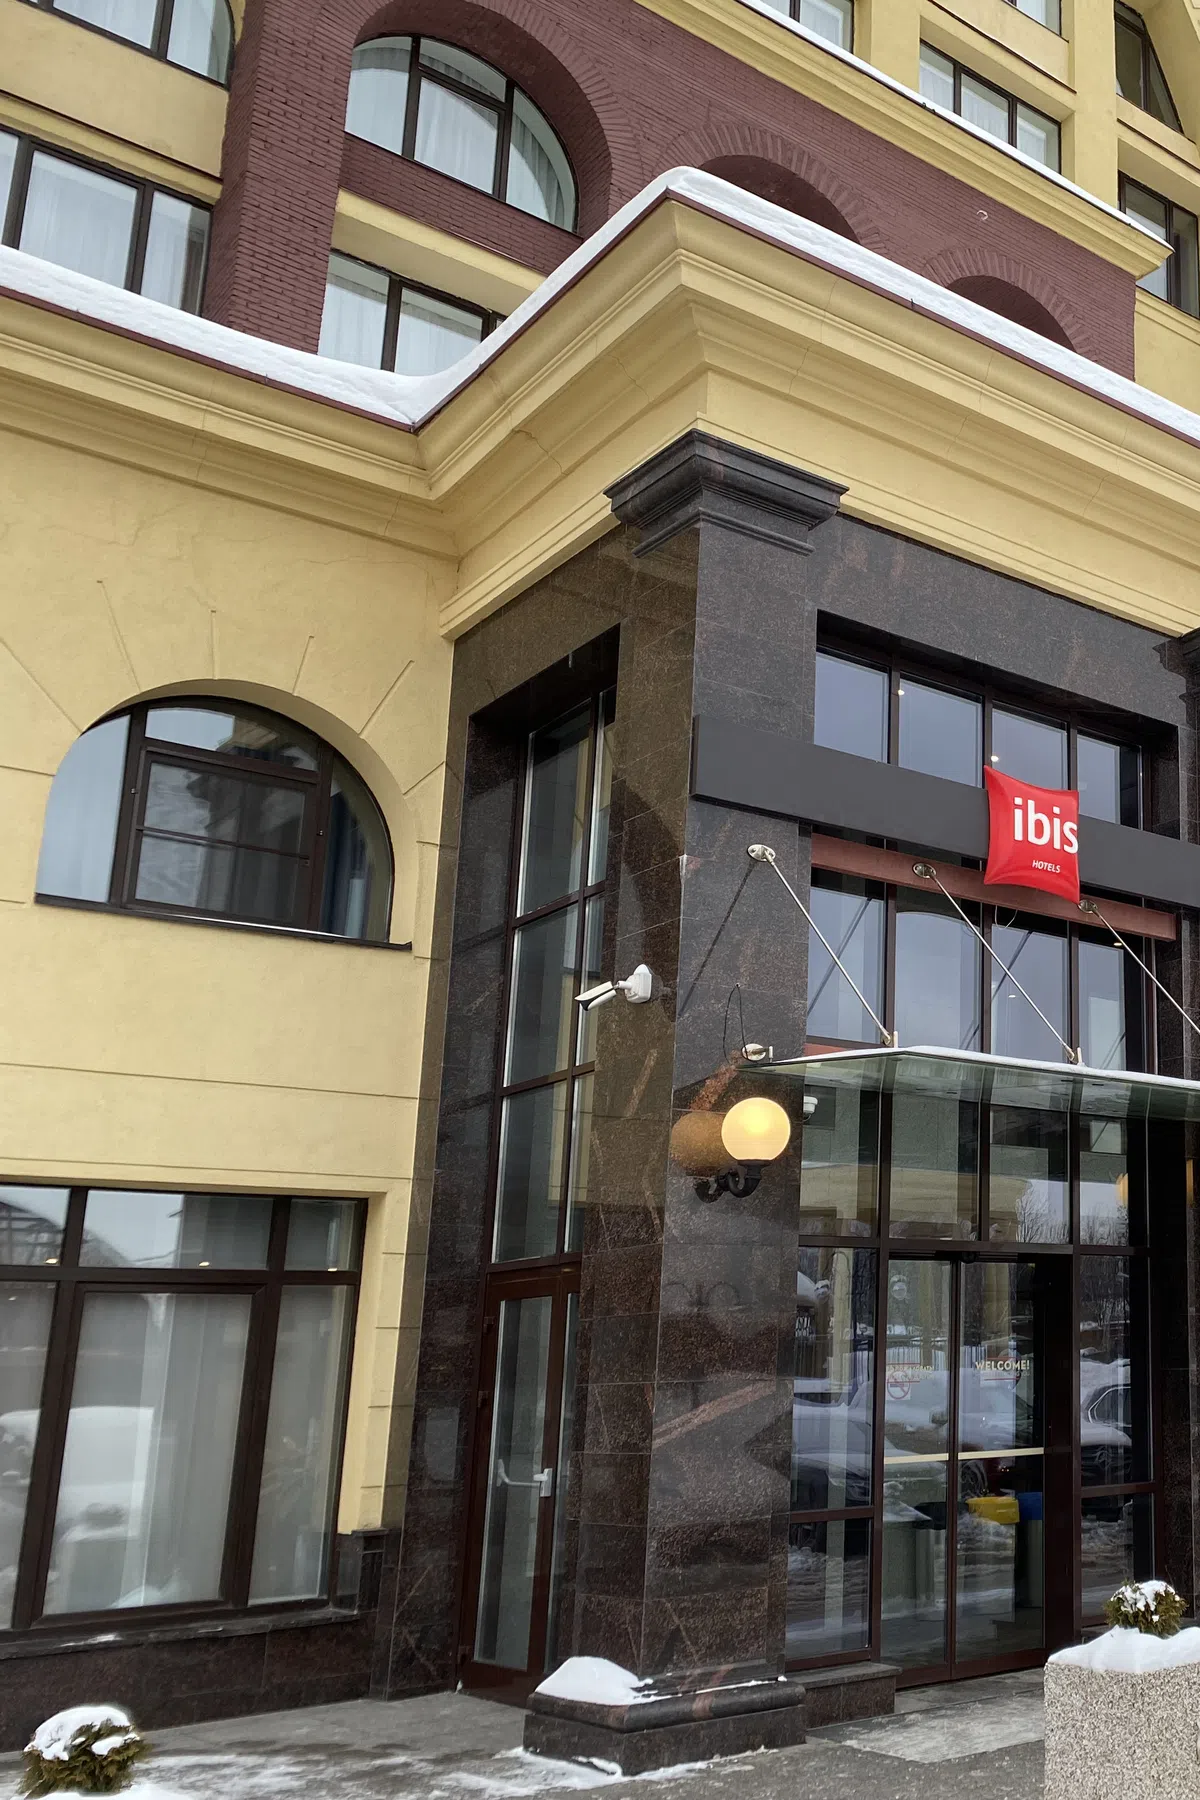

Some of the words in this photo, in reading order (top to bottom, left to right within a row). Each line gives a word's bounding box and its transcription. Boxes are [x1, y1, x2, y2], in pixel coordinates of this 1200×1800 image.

[1014, 796, 1079, 854] ibis
[1032, 859, 1061, 874] HOTELS
[975, 1359, 1030, 1371] WELCOME!
